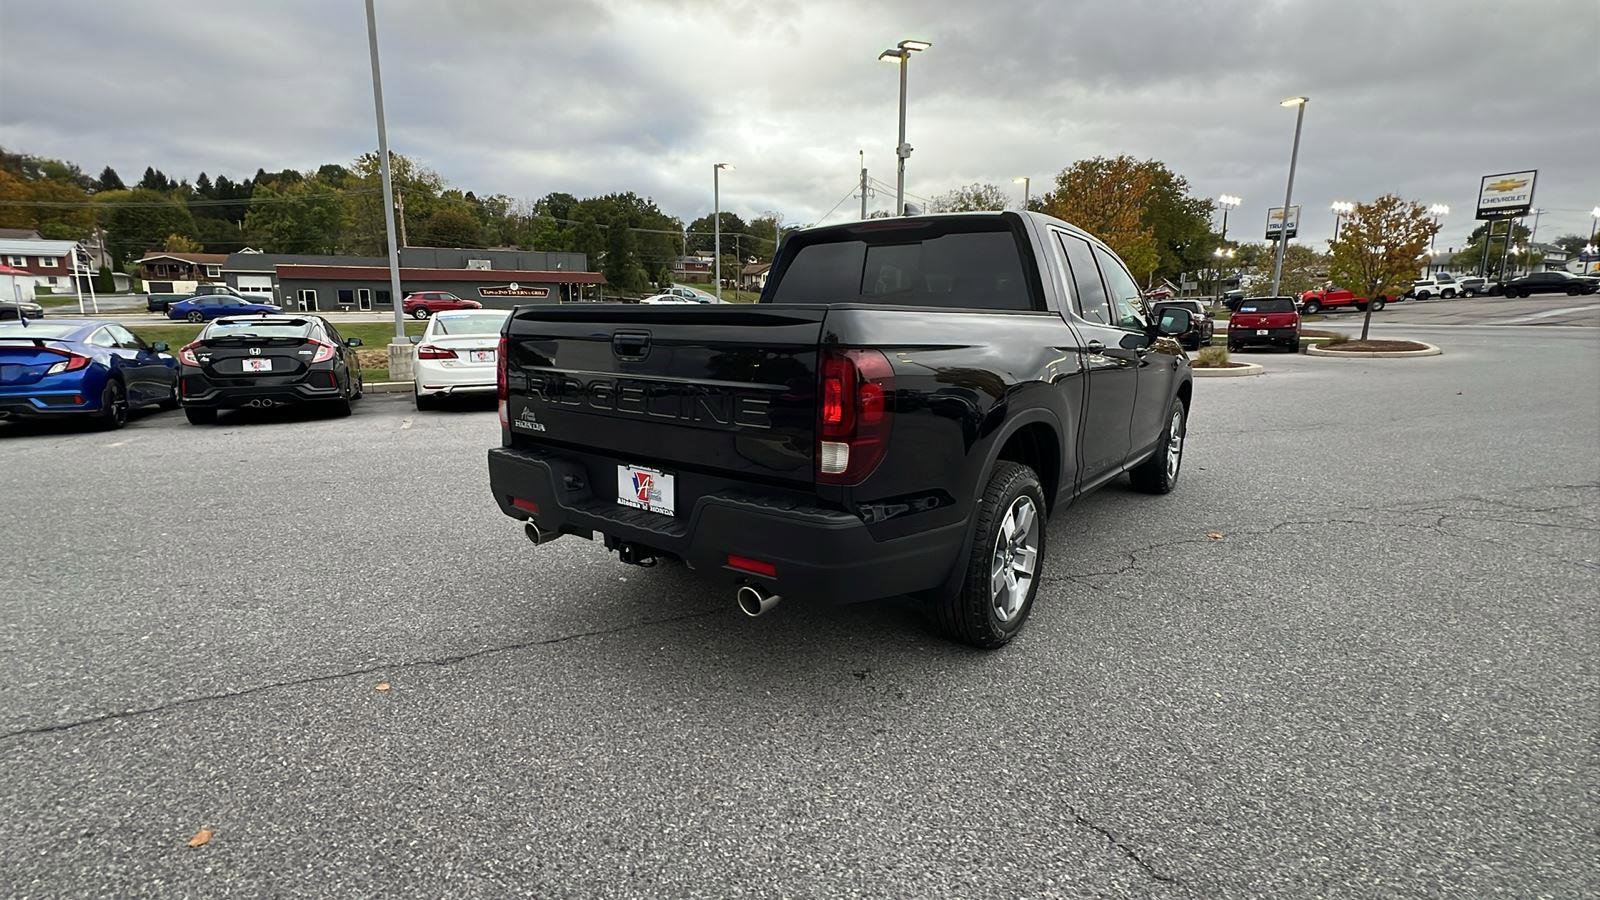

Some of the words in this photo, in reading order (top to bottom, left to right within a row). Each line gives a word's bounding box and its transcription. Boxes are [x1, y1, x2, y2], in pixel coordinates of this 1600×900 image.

[1482, 195, 1526, 204] CHEVROLET
[526, 375, 772, 429] RIDGELINE
[514, 419, 546, 432] HONDA
